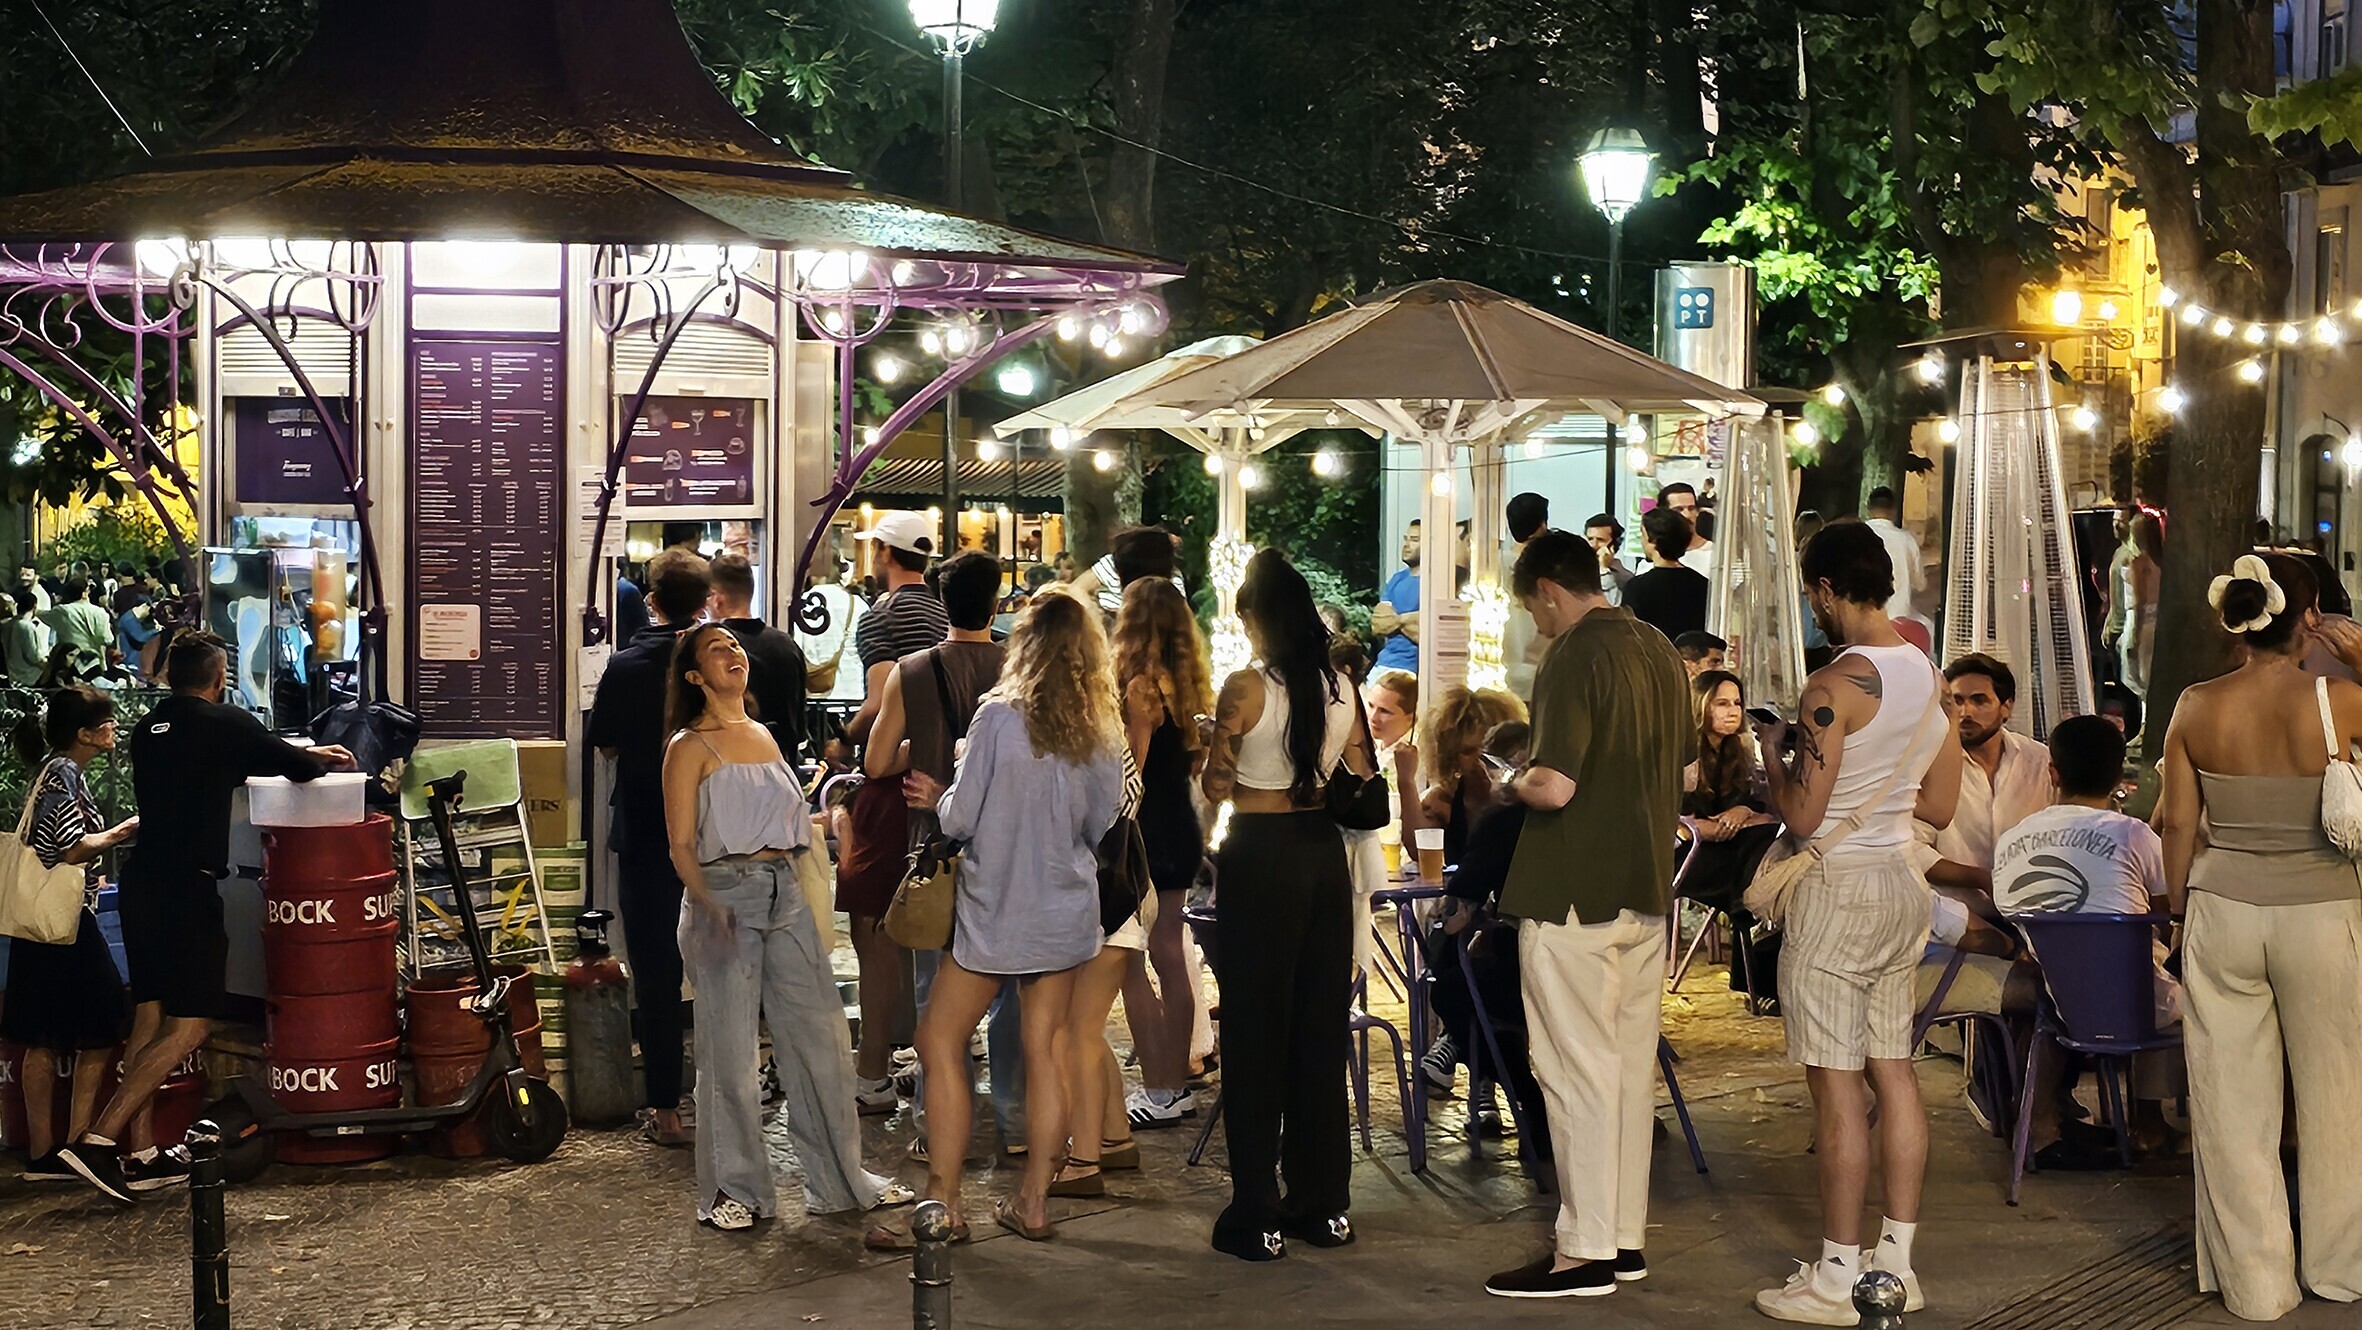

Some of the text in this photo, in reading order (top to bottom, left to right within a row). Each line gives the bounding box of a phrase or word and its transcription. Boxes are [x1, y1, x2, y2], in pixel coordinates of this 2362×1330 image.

[526, 799, 561, 813] ERS
[268, 899, 336, 925] BOCK
[272, 1066, 340, 1092] BOCK
